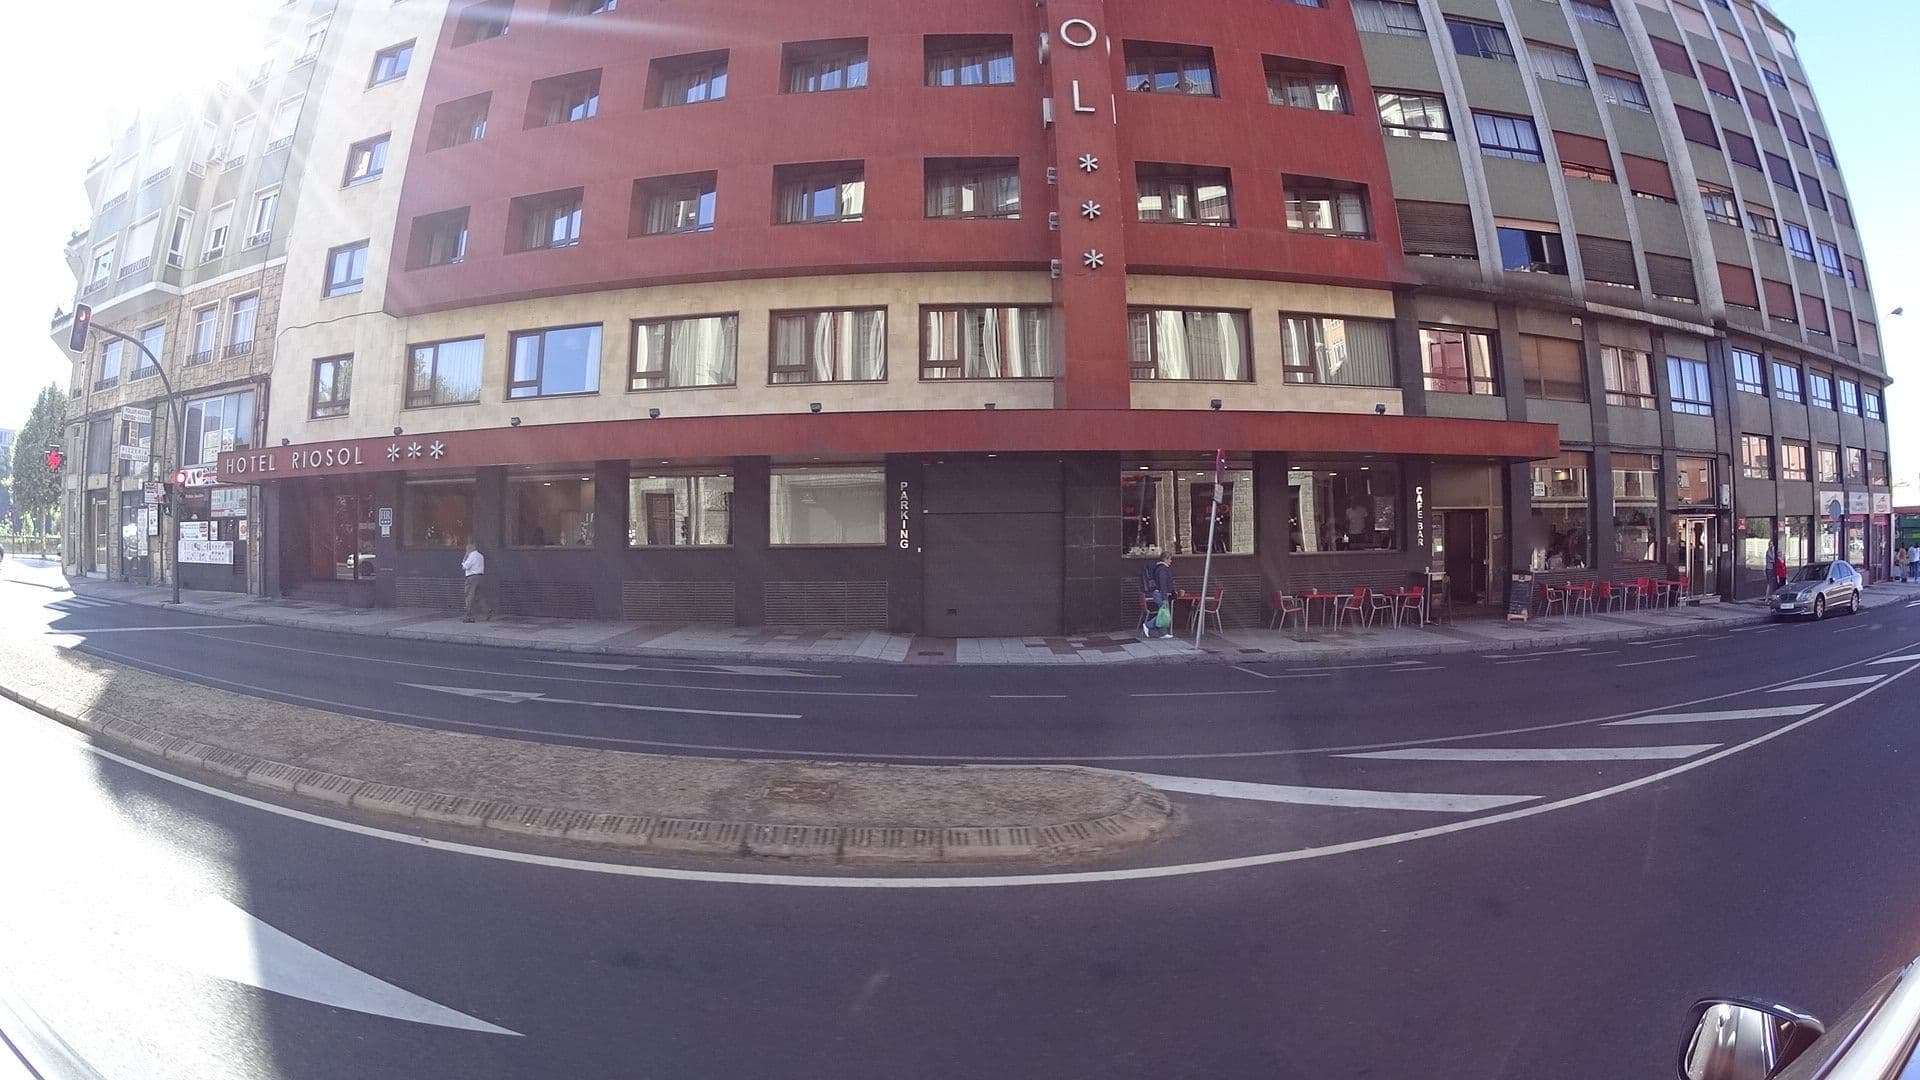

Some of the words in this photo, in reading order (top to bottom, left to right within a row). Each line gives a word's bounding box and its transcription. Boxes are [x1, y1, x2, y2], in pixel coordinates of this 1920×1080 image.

[226, 454, 276, 474] HOTEL
[292, 446, 364, 470] RIOSOL
[900, 481, 909, 549] PARKING
